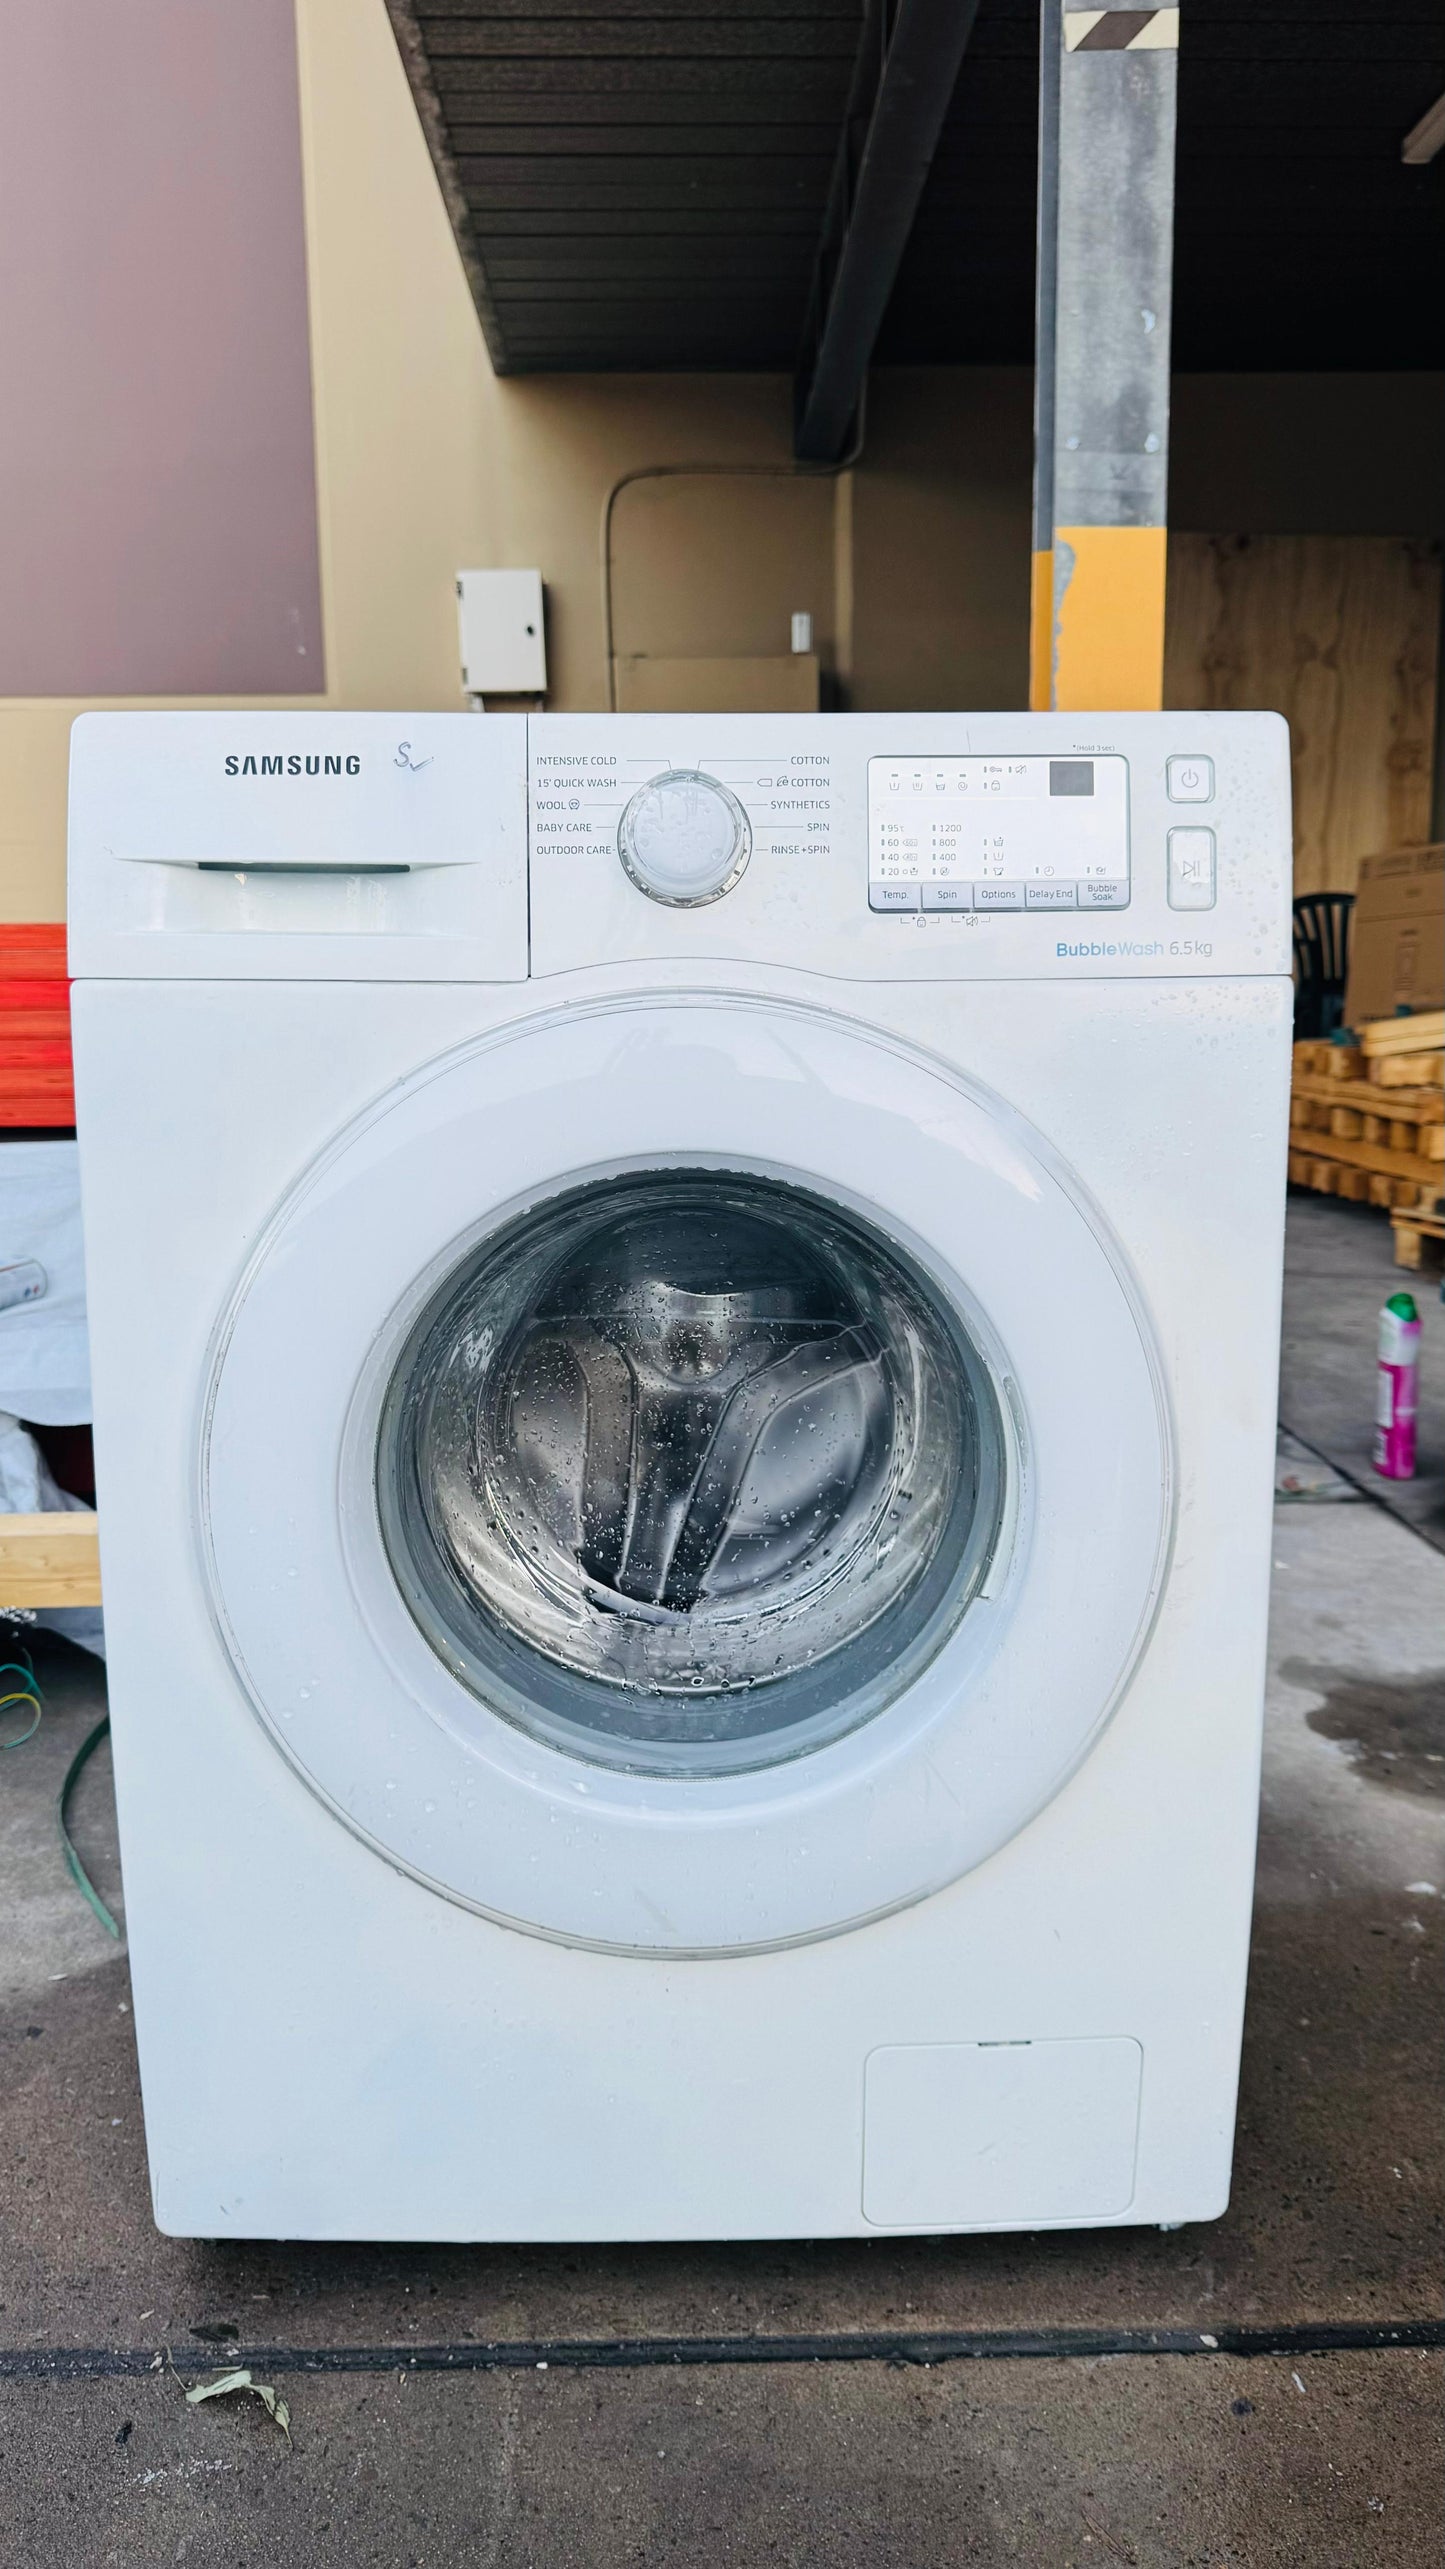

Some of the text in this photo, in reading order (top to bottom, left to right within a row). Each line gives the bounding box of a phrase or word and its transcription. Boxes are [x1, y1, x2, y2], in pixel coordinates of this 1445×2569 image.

[536, 756, 617, 766] INTENSIVE COLD
[790, 756, 830, 765] COTTON
[224, 755, 361, 776] SAMSUNG
[553, 778, 585, 789] QUICK
[586, 778, 617, 788] WASH
[791, 778, 830, 787] COTTON
[536, 801, 567, 810] WOOL
[770, 800, 831, 810] SYNTHETICS
[536, 823, 593, 832] BABY CARE
[807, 822, 830, 832] SPIN
[939, 824, 963, 833] 1200
[887, 838, 900, 847] 60
[939, 838, 957, 847] 800
[536, 845, 612, 855] OUTDOOR CARE
[771, 845, 800, 854] RINSE
[887, 853, 900, 862] 40
[939, 853, 957, 862] 400
[888, 868, 900, 876] 20
[1087, 884, 1118, 893] Bubble
[882, 890, 909, 901] Temp.
[937, 890, 958, 900] Spin
[981, 889, 1017, 900] Options
[1029, 889, 1073, 900] Delay End
[1092, 893, 1113, 901] Soak
